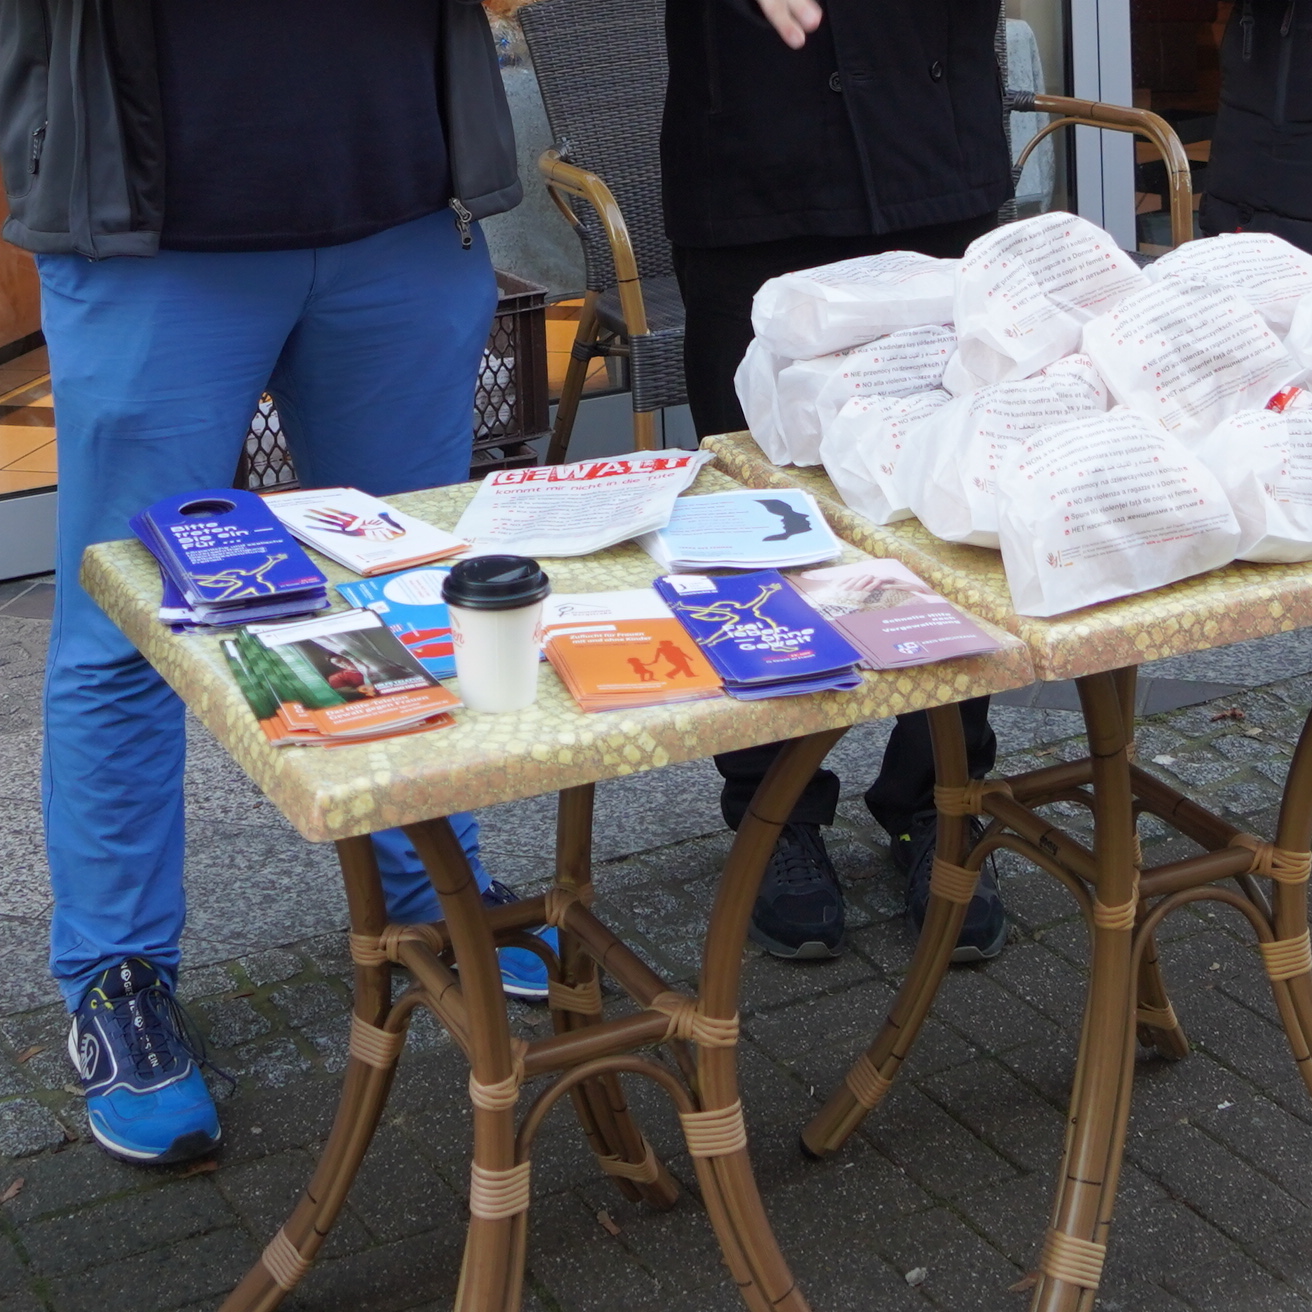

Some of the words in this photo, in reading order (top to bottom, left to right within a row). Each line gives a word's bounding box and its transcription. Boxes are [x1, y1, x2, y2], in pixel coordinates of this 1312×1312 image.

[491, 455, 693, 487] GEWALT
[495, 486, 541, 496] kommt
[545, 484, 567, 492] mir
[570, 482, 603, 492] nicht
[605, 480, 618, 488] in
[621, 476, 641, 485] die
[646, 471, 676, 482] Tüte
[170, 521, 219, 534] Bitte
[172, 525, 238, 539] treten
[881, 614, 926, 625] Schnelle
[927, 611, 952, 619] Hilfe
[882, 619, 962, 633] Vergewaltigung
[394, 695, 430, 708] Frauen
